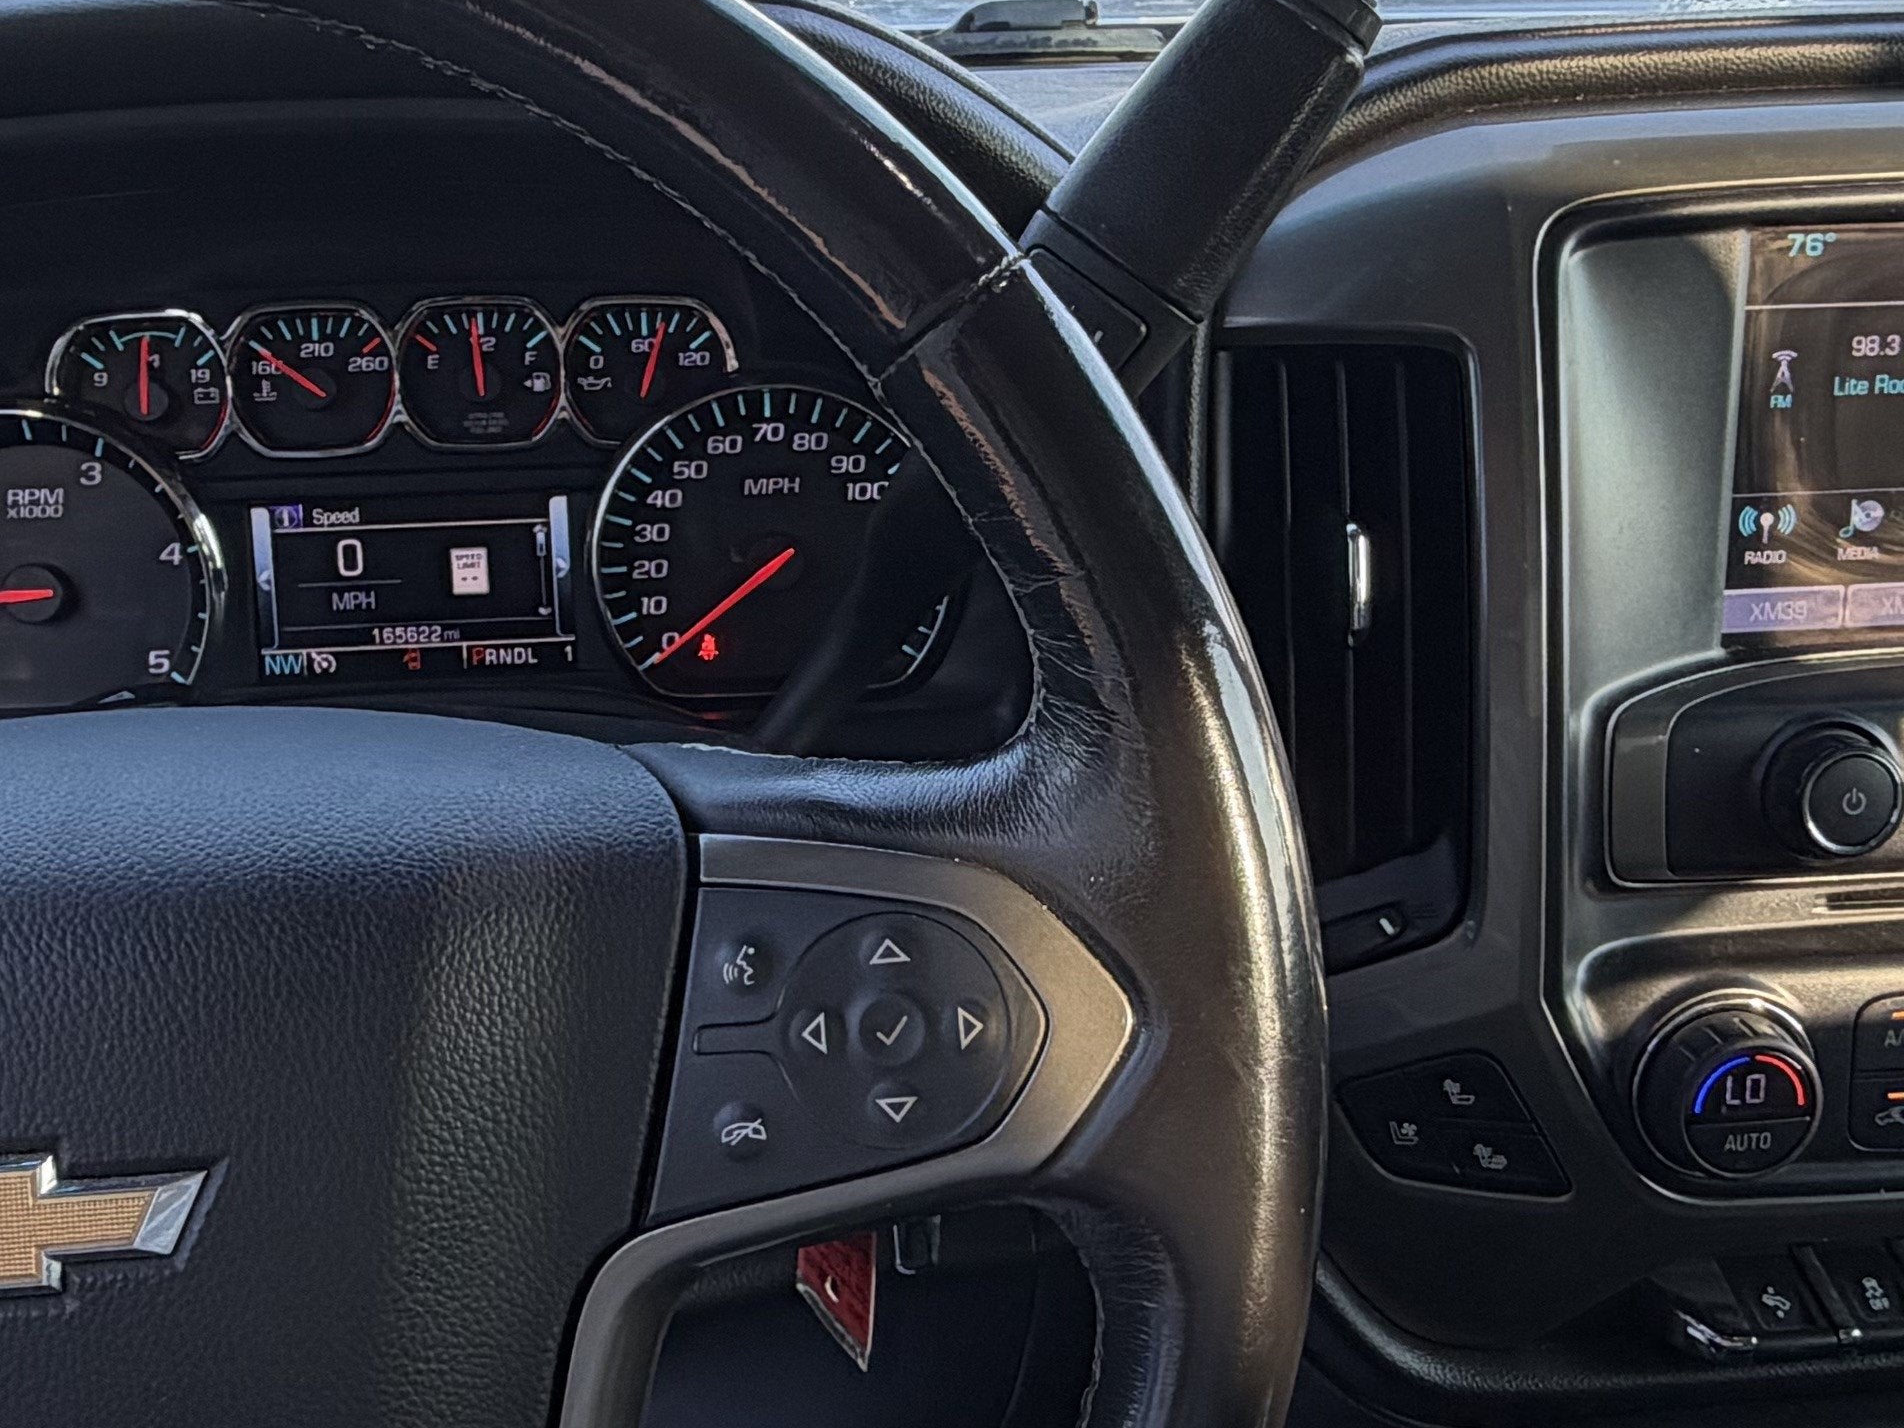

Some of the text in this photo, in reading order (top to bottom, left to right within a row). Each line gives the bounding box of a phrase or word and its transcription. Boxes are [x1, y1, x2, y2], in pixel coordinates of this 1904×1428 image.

[299, 342, 334, 357] 210
[1851, 334, 1902, 358] 98.3
[348, 355, 388, 373] 260
[427, 354, 440, 370] E
[524, 351, 538, 366] F
[589, 355, 605, 369] 0
[678, 351, 710, 367] 120
[94, 372, 109, 387] 9
[191, 368, 211, 383] 19
[1833, 374, 1869, 397] Lite
[1770, 394, 1793, 410] FM
[753, 422, 786, 444] 70
[791, 431, 829, 453] 80
[705, 434, 744, 456] 60
[79, 462, 103, 486] 3
[672, 459, 710, 481] 50
[829, 453, 868, 475] 90
[6, 487, 65, 508] RPM
[743, 476, 802, 497] MPH
[646, 487, 684, 510] 40
[312, 507, 360, 528] Speed
[633, 521, 671, 544] 30
[159, 541, 183, 565] 4
[336, 537, 364, 577] 0
[1744, 550, 1788, 565] RADIO
[1837, 546, 1881, 562] MEDIA
[632, 557, 670, 580] 20
[332, 590, 376, 612] MPH
[640, 595, 668, 617] 10
[371, 625, 461, 645] 165622 mi
[661, 631, 681, 653] 0
[148, 650, 171, 674] 5
[264, 653, 303, 675] NW
[472, 645, 574, 666] PRNDL 1
[1724, 1072, 1766, 1106] LO
[1723, 1129, 1773, 1153] AUTO
